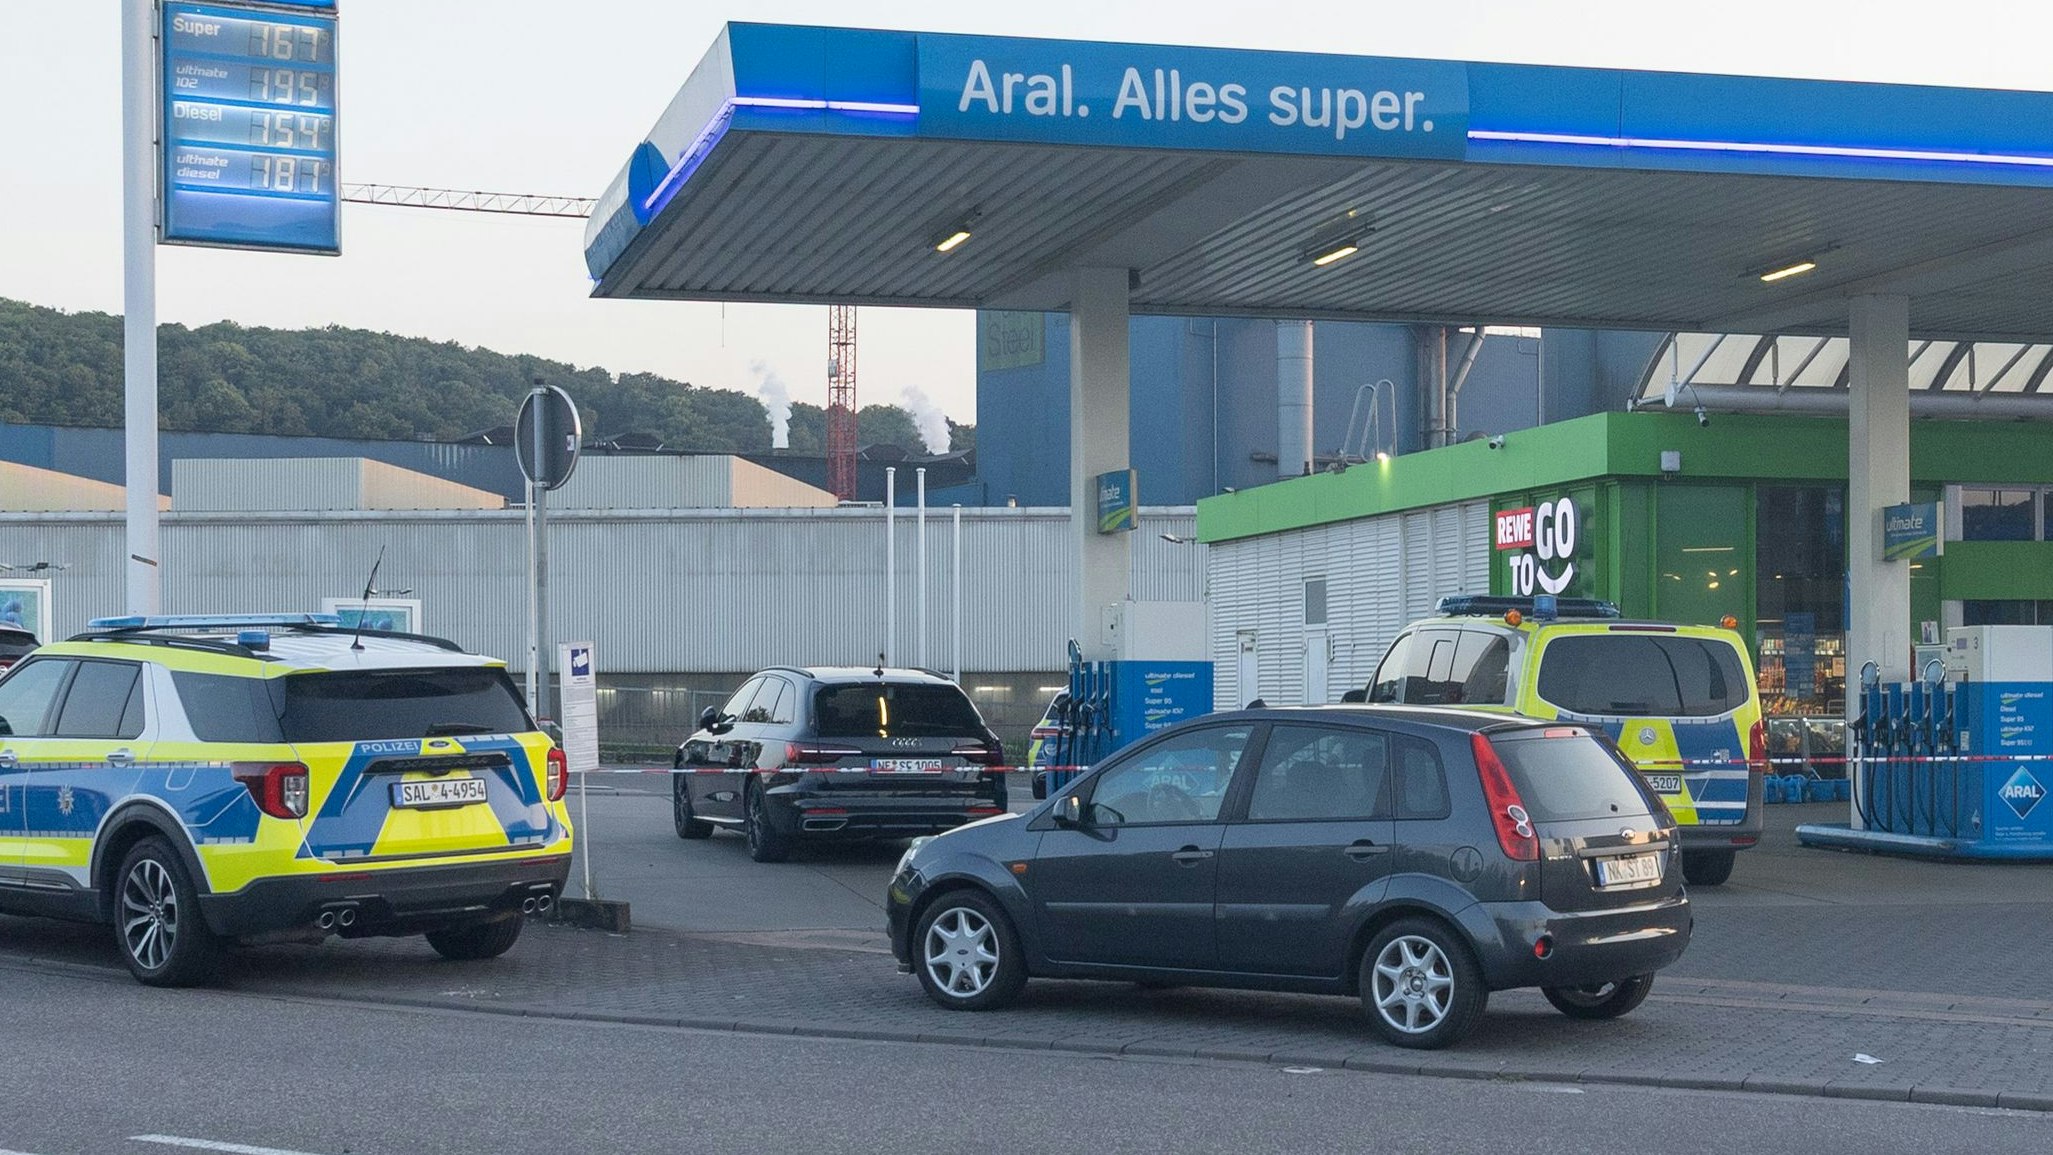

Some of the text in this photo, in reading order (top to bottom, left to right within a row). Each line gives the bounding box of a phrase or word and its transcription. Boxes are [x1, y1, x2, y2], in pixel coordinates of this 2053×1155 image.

[172, 17, 221, 36] Super
[176, 65, 228, 79] ultimate
[175, 77, 198, 89] 102
[958, 59, 1435, 140] Aral. Alles super.
[173, 102, 222, 122] Diesel
[261, 112, 319, 149] 154
[176, 153, 229, 168] ultimate
[176, 167, 220, 180] diesel
[1497, 497, 1575, 560] REWE GO
[1509, 553, 1534, 596] TO
[1973, 635, 1979, 651] 3
[1144, 697, 1163, 705] Super
[360, 741, 420, 753] POLIZEI
[404, 782, 485, 802] SAL 4-4954
[2005, 785, 2041, 798] ARAL
[1607, 861, 1623, 881] NK
